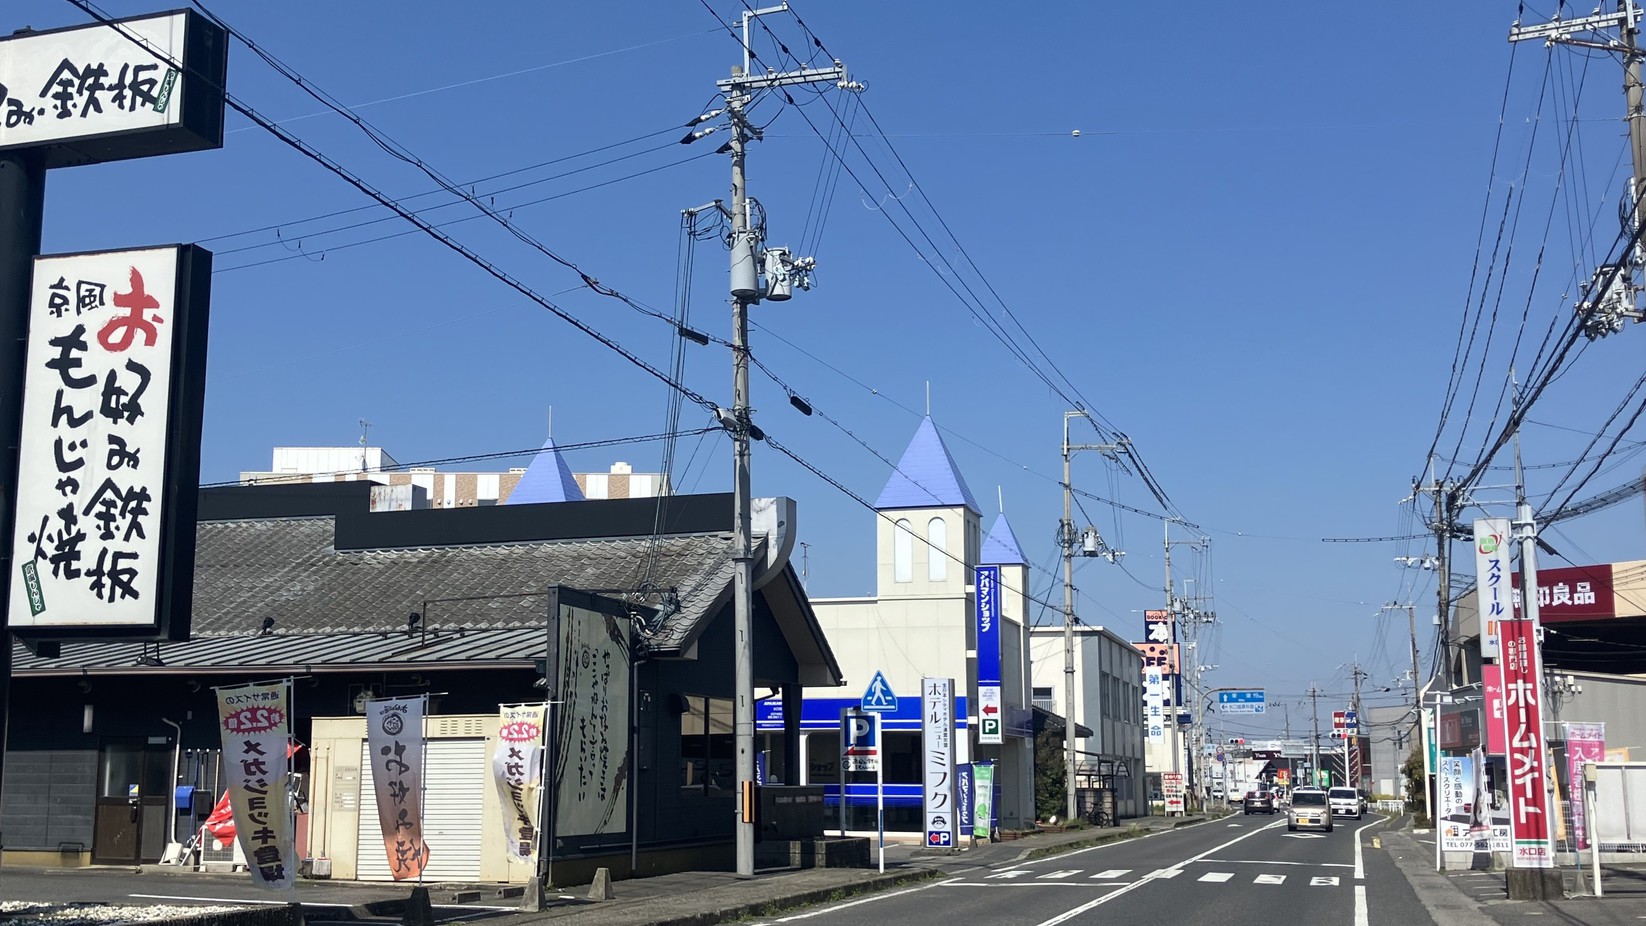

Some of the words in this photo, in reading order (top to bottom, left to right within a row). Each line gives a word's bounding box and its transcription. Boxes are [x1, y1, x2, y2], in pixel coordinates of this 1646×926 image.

[48, 276, 106, 317] 京風
[27, 323, 98, 580] もんじゃ焼
[980, 571, 991, 632] アパマンショップ
[1487, 559, 1505, 617] スクール
[1148, 674, 1162, 736] 第一生命
[849, 718, 870, 745] P
[985, 719, 997, 733] P
[1569, 731, 1603, 739] ホームメイト
[1507, 679, 1542, 824] ホームメイト
[940, 832, 950, 845] P
[1519, 847, 1546, 856] 水口店
